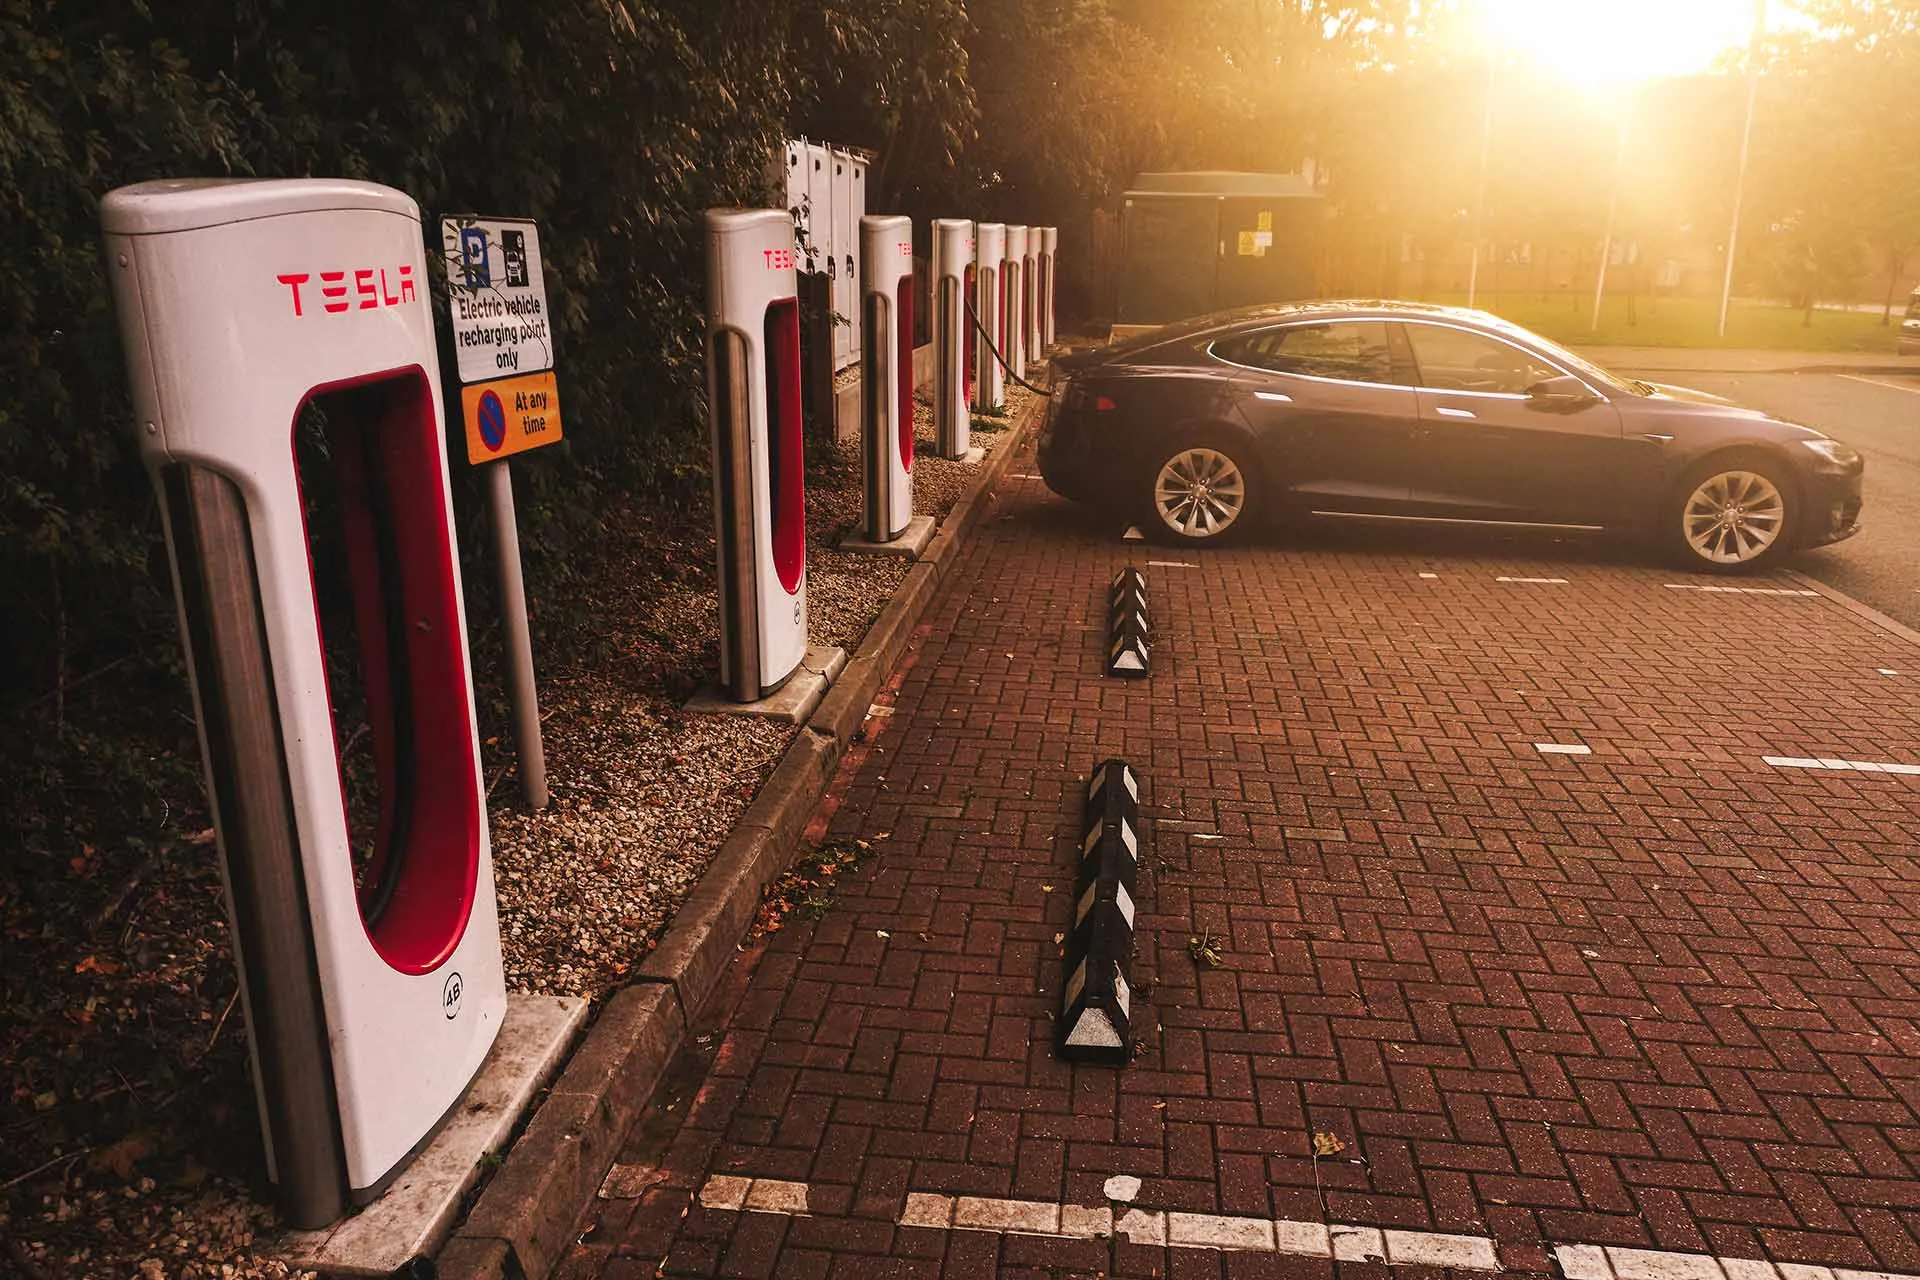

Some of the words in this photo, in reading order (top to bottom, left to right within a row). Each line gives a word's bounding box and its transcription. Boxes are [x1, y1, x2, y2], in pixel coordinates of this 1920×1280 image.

[467, 236, 484, 282] P
[277, 266, 415, 316] TESLA
[459, 297, 502, 319] Electric
[505, 295, 541, 316] vehicle
[459, 323, 518, 347] recharging
[520, 319, 546, 344] point
[496, 347, 518, 370] only
[515, 392, 528, 411] At
[529, 391, 548, 410] any
[523, 416, 546, 435] time
[446, 982, 460, 1006] 4B
